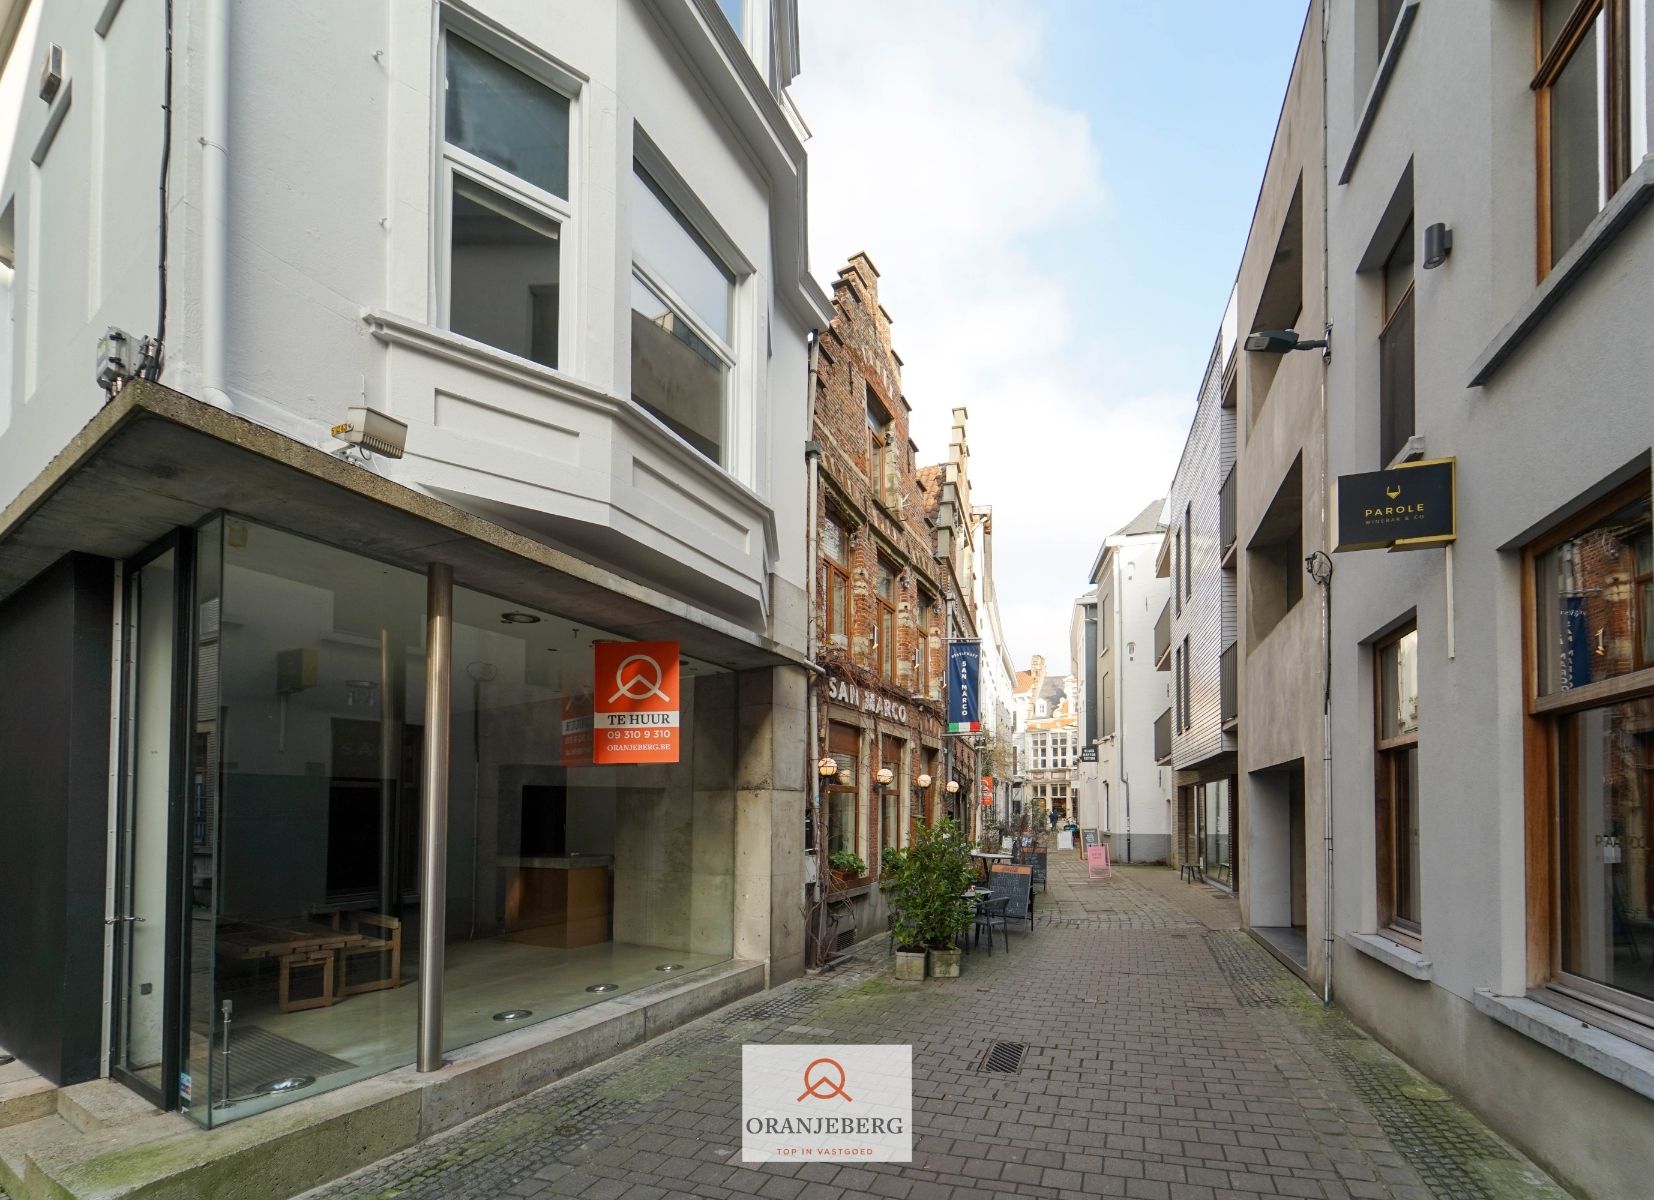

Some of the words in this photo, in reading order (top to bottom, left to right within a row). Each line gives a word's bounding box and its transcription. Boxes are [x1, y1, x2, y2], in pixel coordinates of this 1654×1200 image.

[1365, 503, 1424, 517] PAROLE
[829, 676, 860, 706] SAN
[864, 690, 907, 723] MARCO
[607, 714, 626, 725] TE
[629, 713, 671, 725] HUUR
[607, 730, 621, 740] 09
[623, 730, 641, 740] 310
[643, 730, 651, 739] 9
[653, 729, 671, 739] 310
[606, 743, 671, 752] ORANJEBERG.BE
